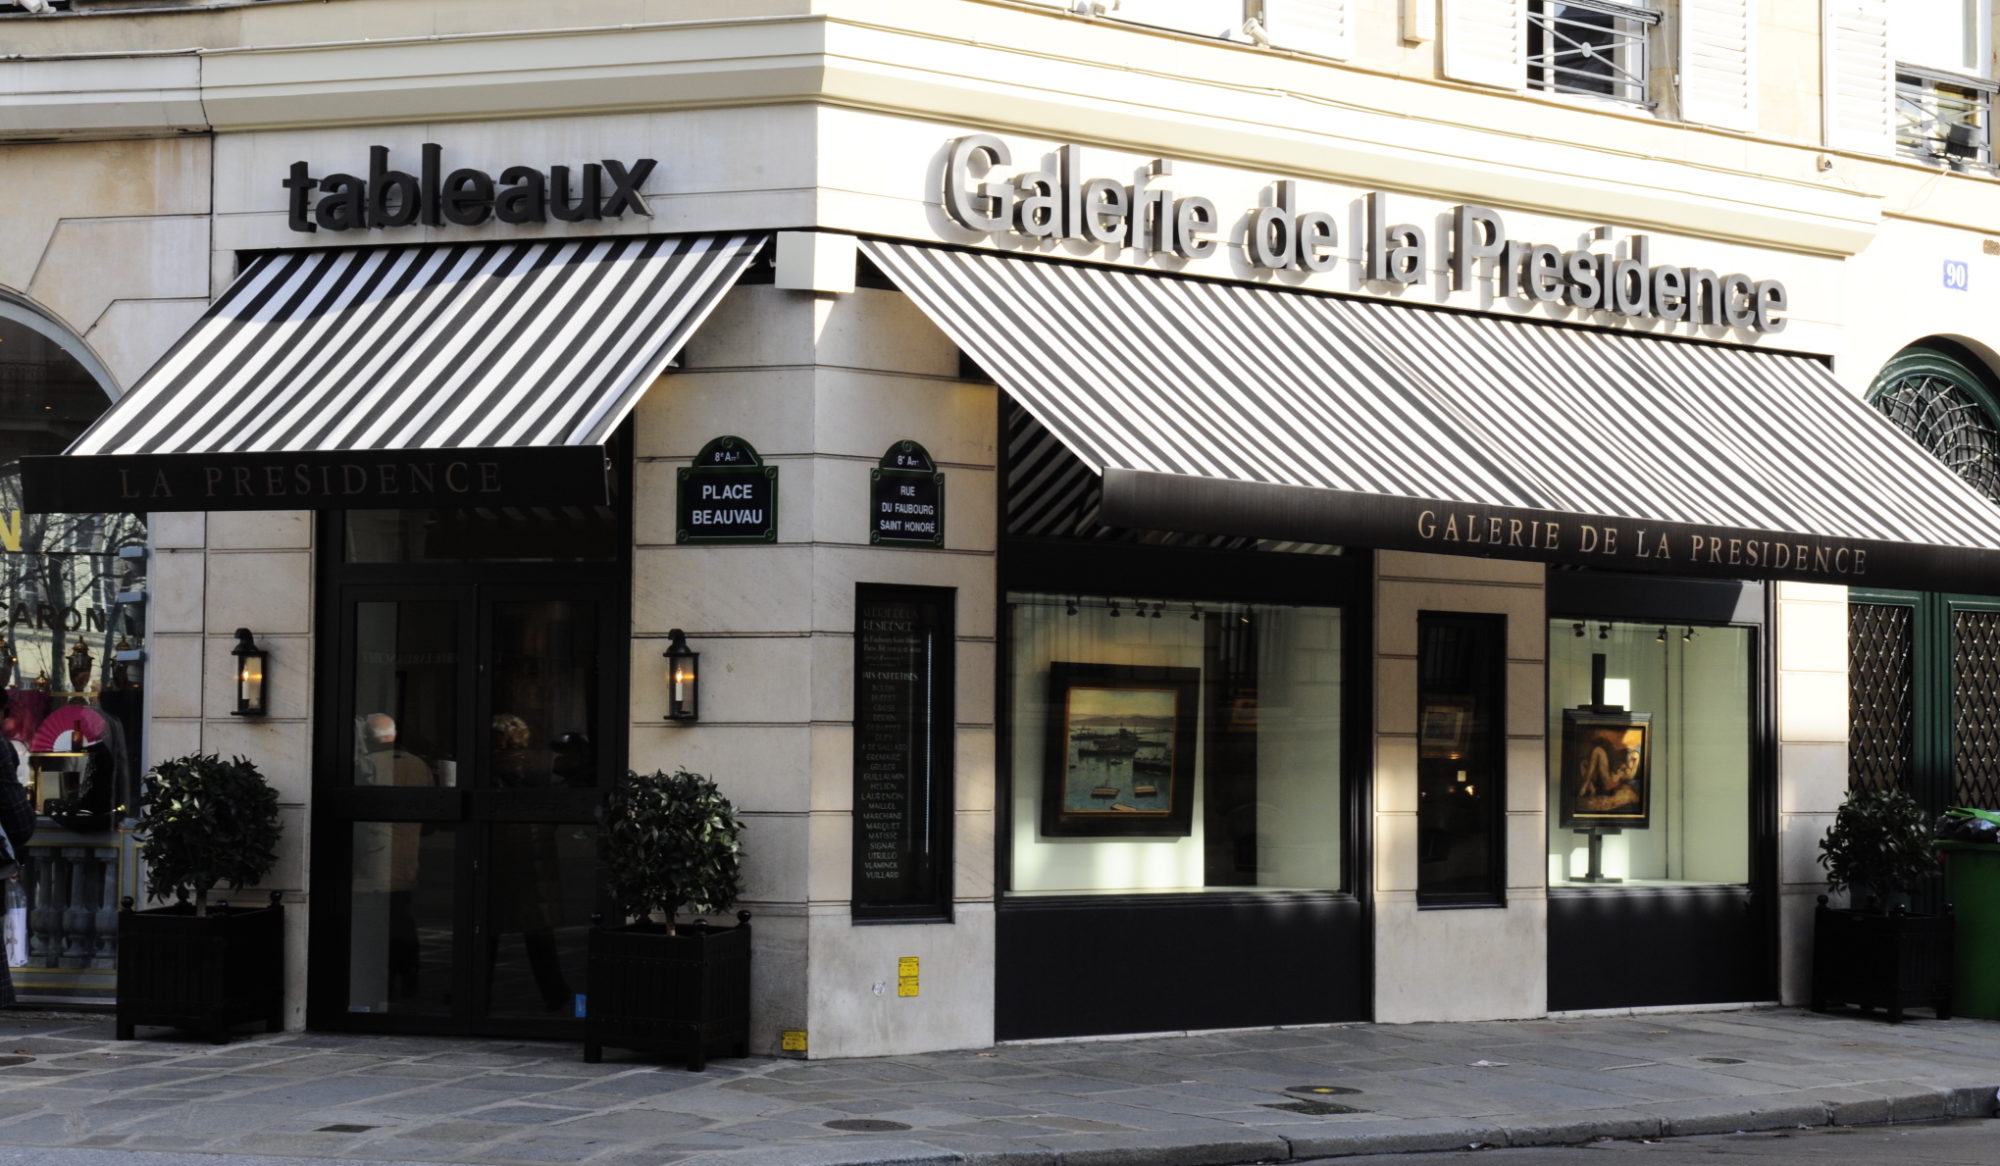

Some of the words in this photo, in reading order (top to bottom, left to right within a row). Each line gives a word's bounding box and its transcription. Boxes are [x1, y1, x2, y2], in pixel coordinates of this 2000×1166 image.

[282, 142, 659, 234] tableaux
[945, 133, 1218, 260] Galerie
[1247, 179, 1339, 273] de
[1366, 191, 1427, 286] la
[1451, 204, 1789, 334] Presidence
[1946, 262, 1967, 288] 90
[118, 467, 175, 499] LA
[203, 461, 503, 498] PRESIDENCE
[900, 484, 917, 497] RUE
[702, 483, 754, 500] PLACE
[692, 508, 764, 525] BEAUVAU
[881, 501, 893, 513] DU
[894, 502, 935, 516] FAUBOURG
[880, 519, 902, 531] SAINT
[1417, 509, 1561, 551] GALERIE
[1578, 524, 1619, 556] DE
[1636, 529, 1672, 560] LA
[1690, 534, 1868, 576] PRESIDENCE
